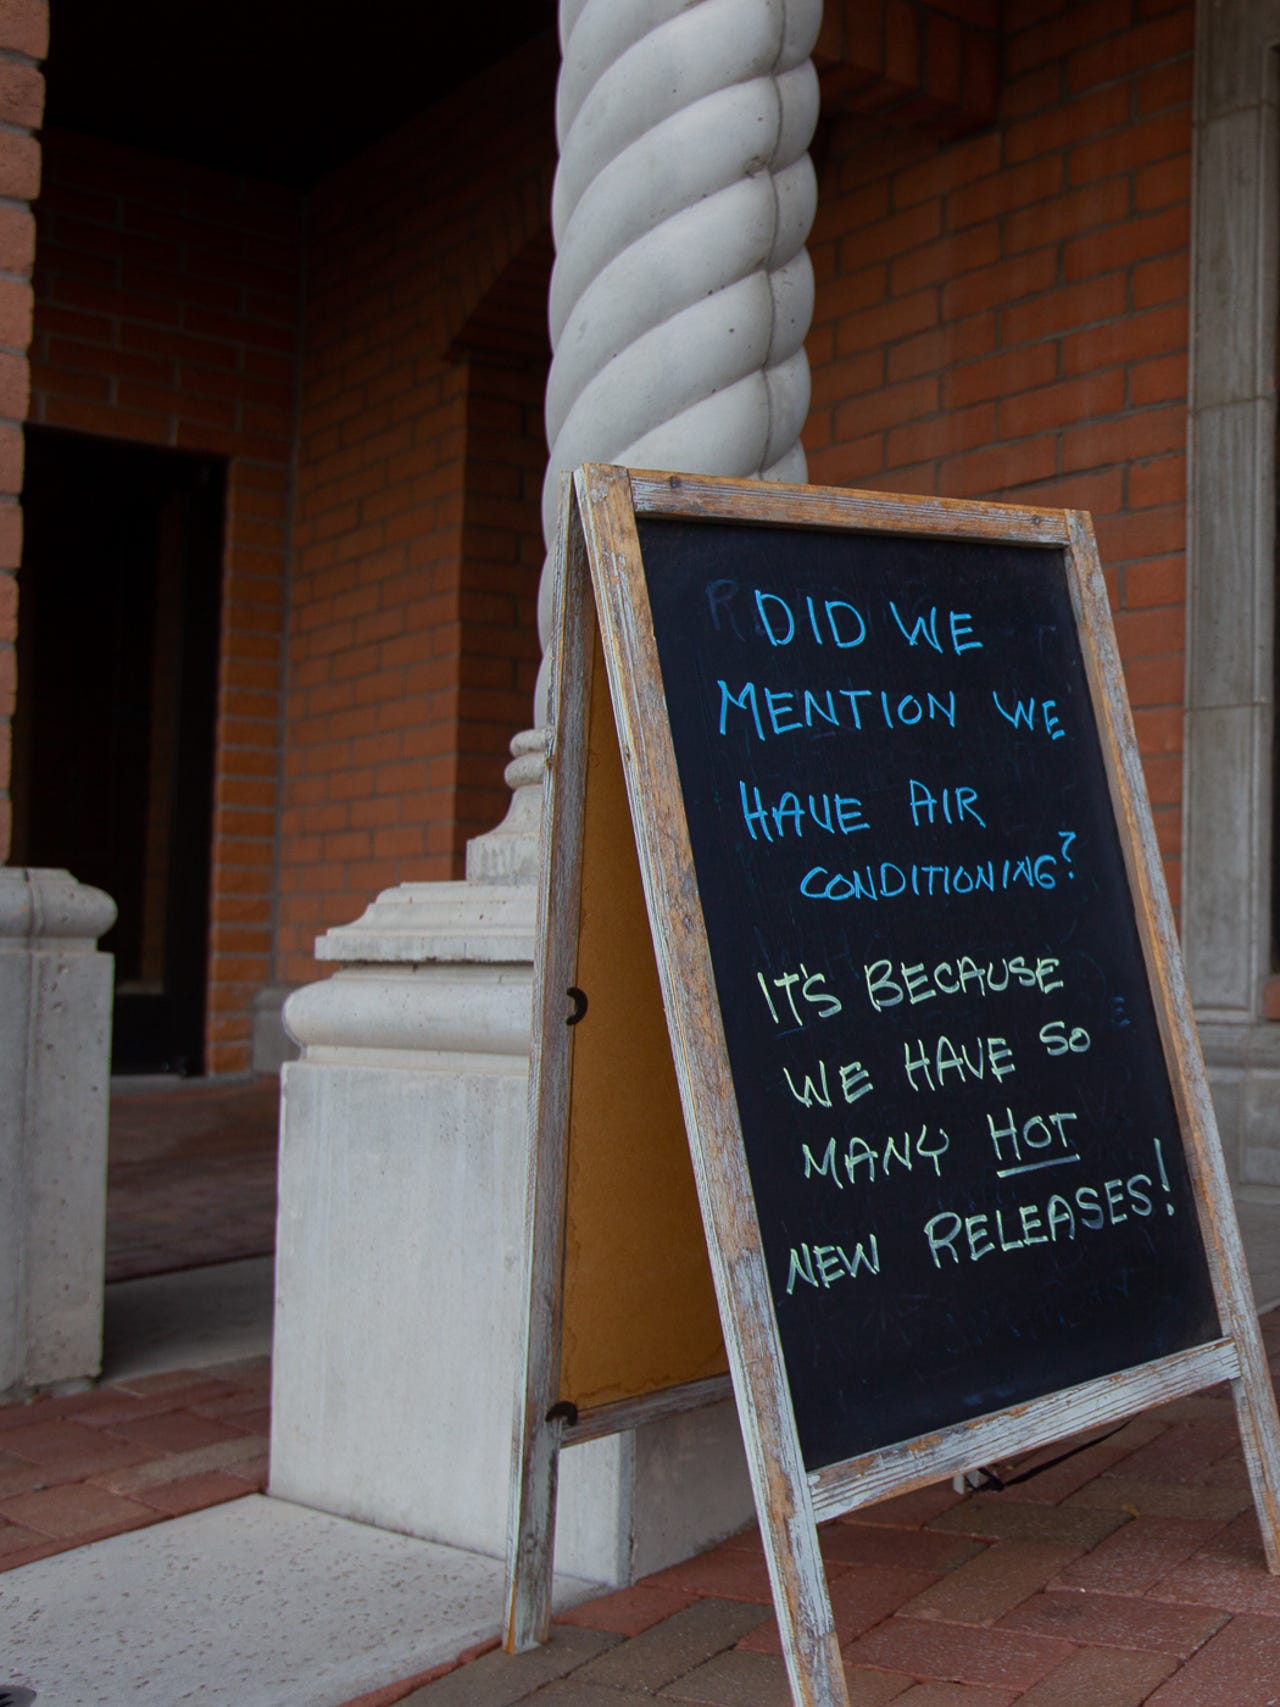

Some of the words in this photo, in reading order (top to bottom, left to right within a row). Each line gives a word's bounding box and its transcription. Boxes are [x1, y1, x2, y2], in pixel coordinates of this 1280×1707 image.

[753, 588, 866, 649] DID
[888, 600, 984, 656] WE
[716, 679, 956, 742] MENTION
[992, 690, 1066, 741] WE
[738, 779, 871, 843] HAVE
[908, 778, 987, 829] AIR
[799, 831, 1077, 901] CONDITIONING?
[756, 962, 843, 1027] IT'S
[863, 955, 1064, 1013] BECAUSE
[782, 1059, 874, 1109] WE
[903, 1035, 1016, 1092] HAVE
[1039, 1020, 1091, 1056] SO
[801, 1124, 950, 1190] MANY
[986, 1107, 1081, 1178] HOT
[786, 1233, 881, 1295] NEW
[923, 1137, 1175, 1269] RELEASES!
